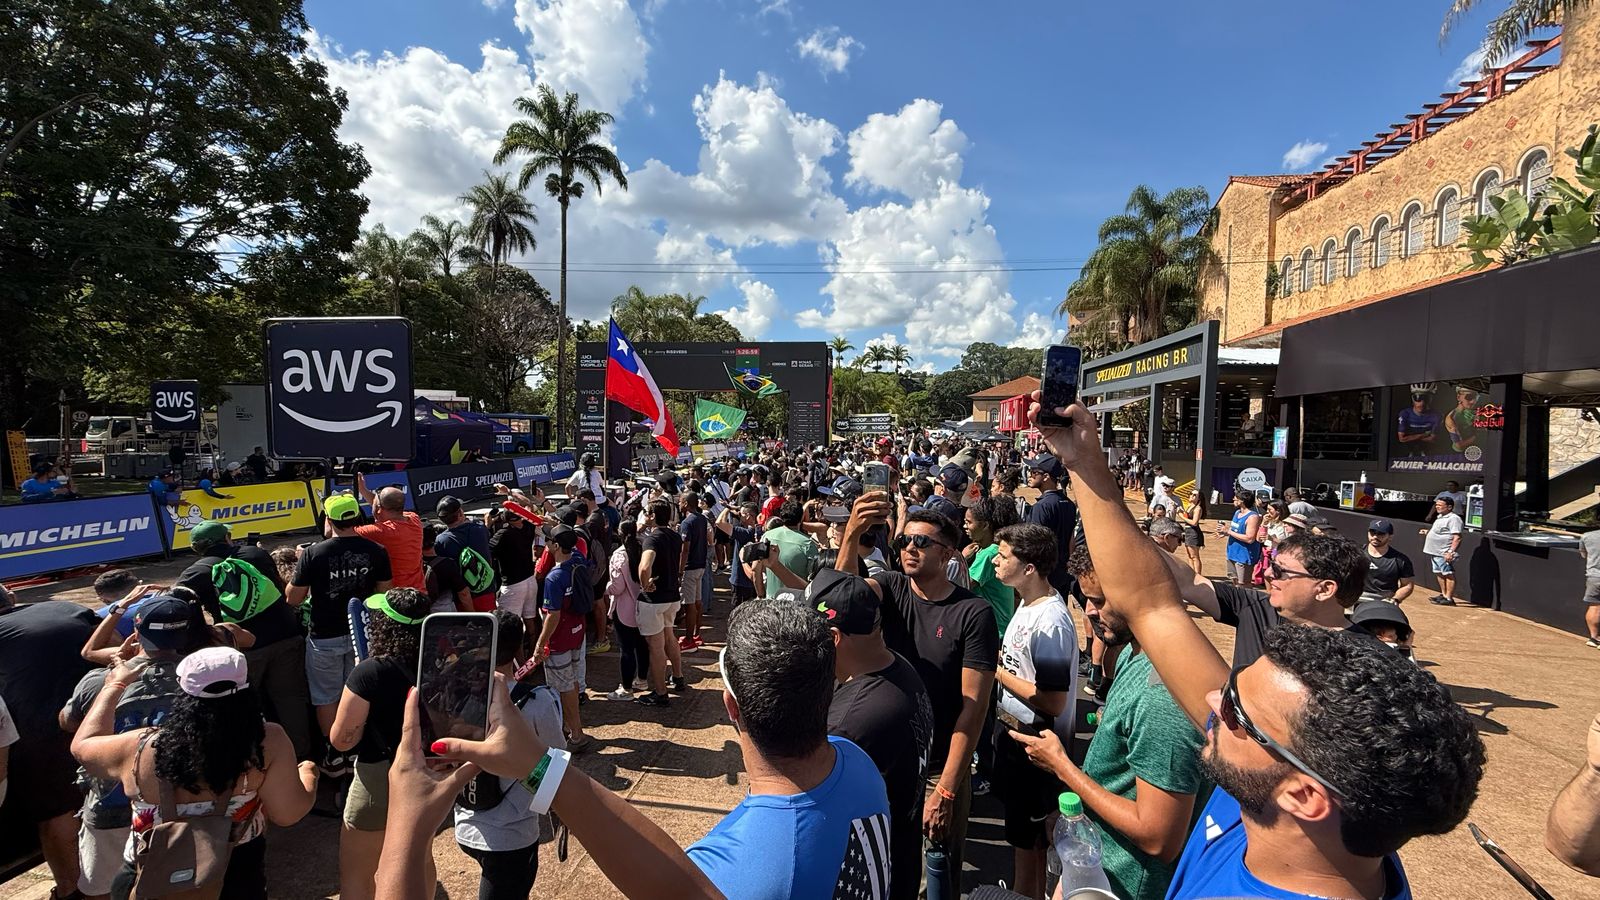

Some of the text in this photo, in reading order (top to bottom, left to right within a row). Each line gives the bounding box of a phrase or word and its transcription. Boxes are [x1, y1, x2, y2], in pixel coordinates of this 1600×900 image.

[281, 348, 397, 394] aws
[1096, 347, 1187, 383] SPECIALIZED RACING BR
[155, 390, 195, 409] aws
[615, 421, 631, 434] aws
[518, 464, 548, 478] SHIMANO
[551, 460, 575, 472] SHIMANO
[1391, 460, 1483, 472] XAVIER-MALACARNE
[418, 476, 468, 497] SPECIALIZED
[475, 471, 513, 487] SPECIALIZED
[211, 497, 306, 520] MICHELIN
[0, 516, 150, 549] MICHELIN
